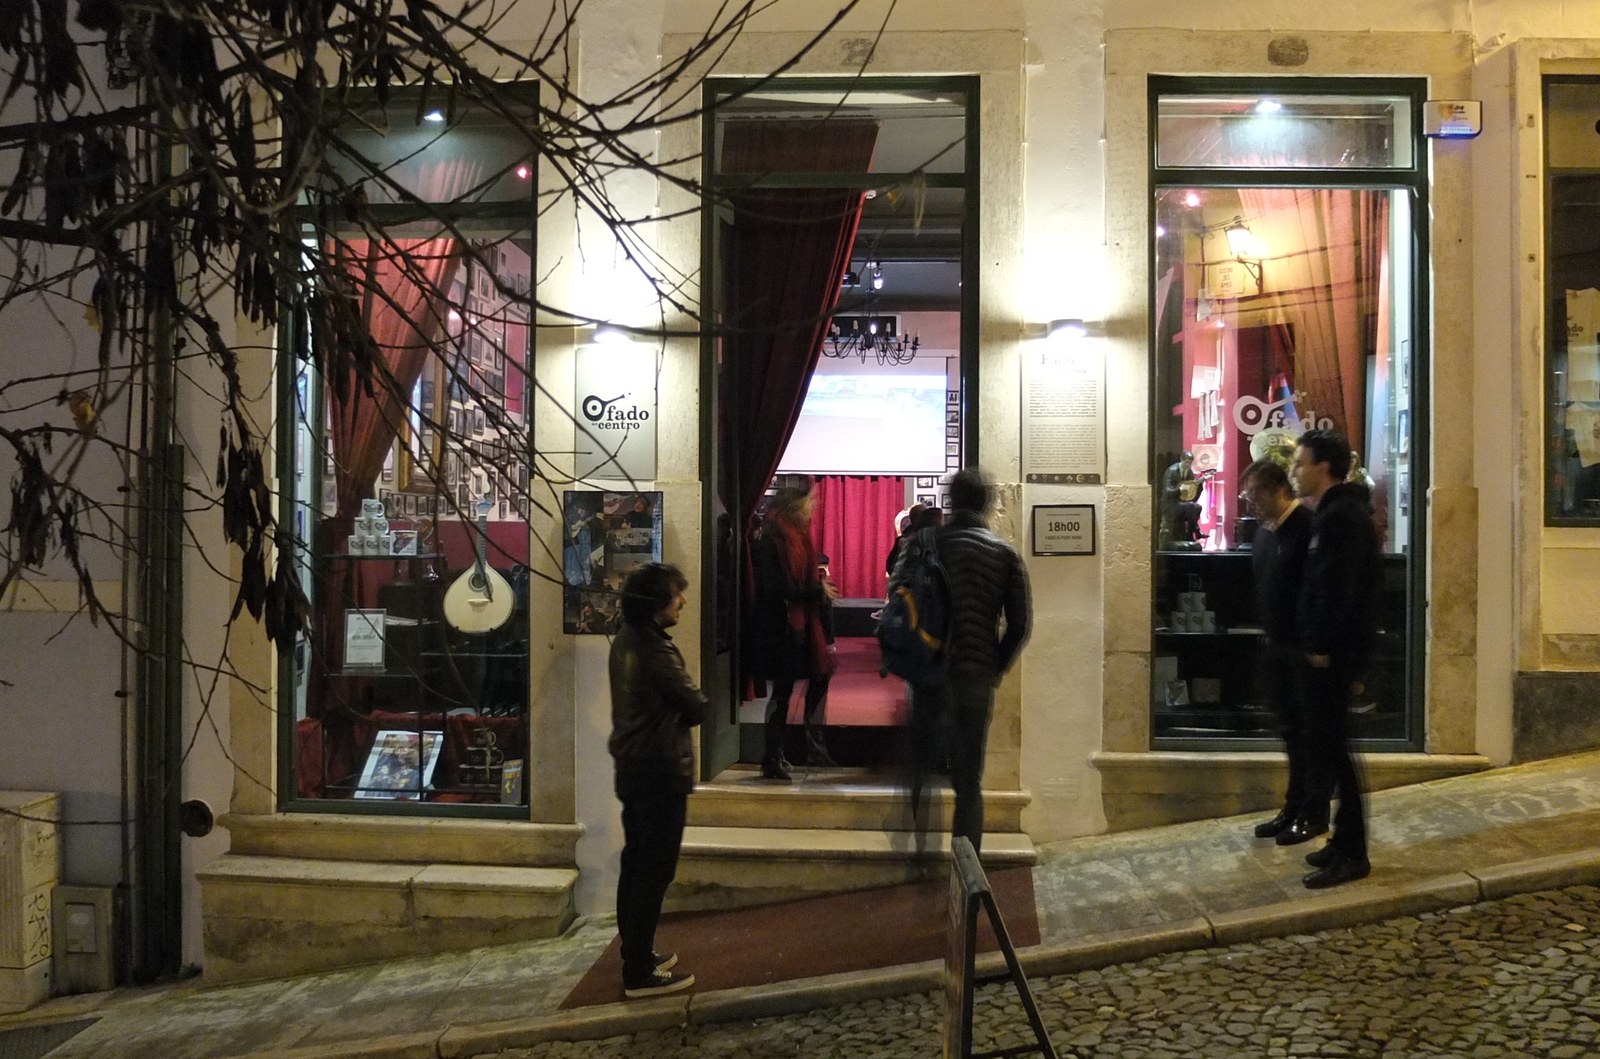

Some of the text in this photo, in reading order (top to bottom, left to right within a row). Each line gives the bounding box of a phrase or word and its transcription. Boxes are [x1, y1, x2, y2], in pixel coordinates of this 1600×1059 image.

[606, 405, 650, 421] fado
[598, 422, 640, 430] centro
[1269, 410, 1334, 432] fado
[1048, 521, 1080, 532] 18h00
